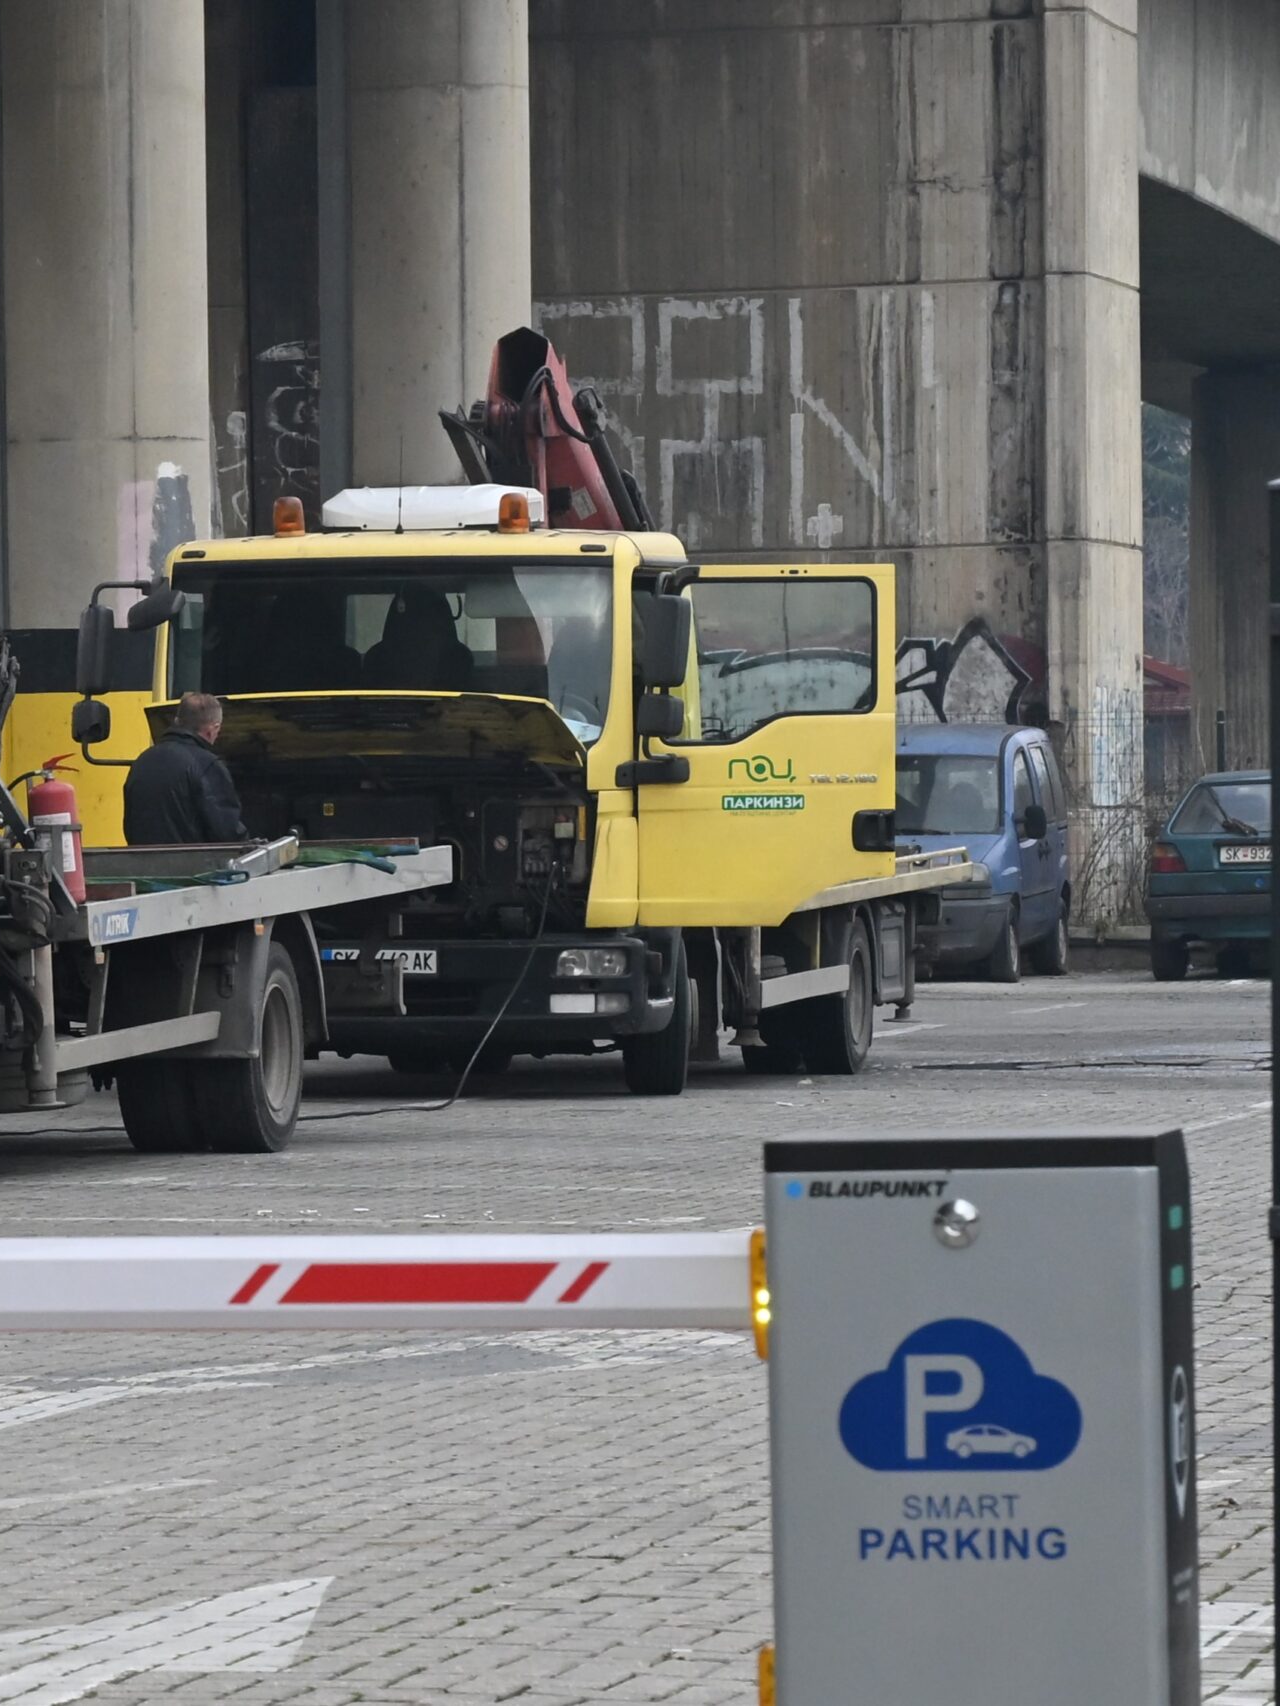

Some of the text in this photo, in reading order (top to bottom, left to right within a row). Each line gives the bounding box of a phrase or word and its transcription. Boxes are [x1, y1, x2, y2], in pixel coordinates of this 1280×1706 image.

[723, 796, 803, 809] ПАРКИНЗИ
[1225, 847, 1240, 860] SK
[413, 952, 433, 971] AK
[808, 1180, 948, 1198] BLAUPUNKT
[902, 1493, 1020, 1521] SMART
[858, 1527, 1068, 1562] PARKING
